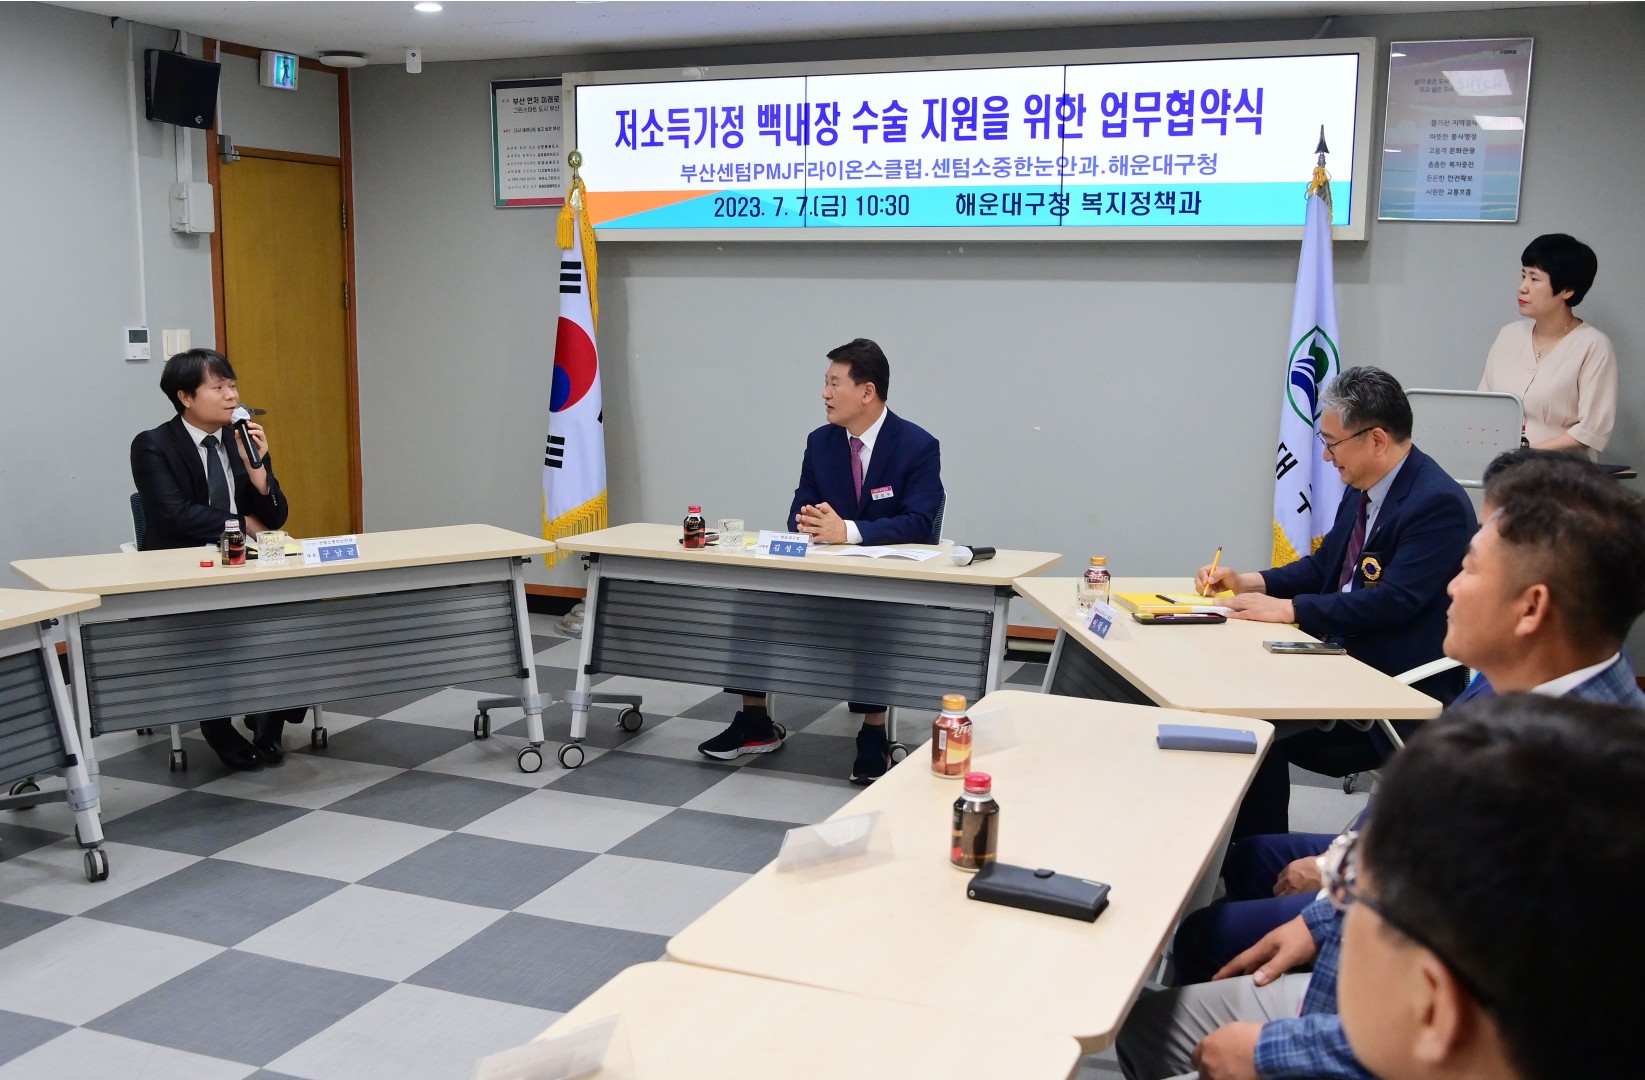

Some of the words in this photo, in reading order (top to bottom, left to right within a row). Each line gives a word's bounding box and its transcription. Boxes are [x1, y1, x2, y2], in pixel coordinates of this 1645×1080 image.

[614, 106, 744, 151] 저소득가정
[757, 100, 841, 147] 백내장
[852, 99, 908, 144] 수술
[920, 95, 1010, 143] 지원을
[1023, 92, 1087, 140] 위한
[1100, 87, 1264, 138] 업무협약식
[714, 196, 765, 218] 2023.
[772, 196, 789, 217] 7.
[795, 194, 848, 218] 7.(금)
[855, 193, 911, 217] 10:30
[955, 192, 1070, 217] 해운대구청
[1081, 190, 1202, 216] 복지정책과
[773, 544, 804, 554] 김성수
